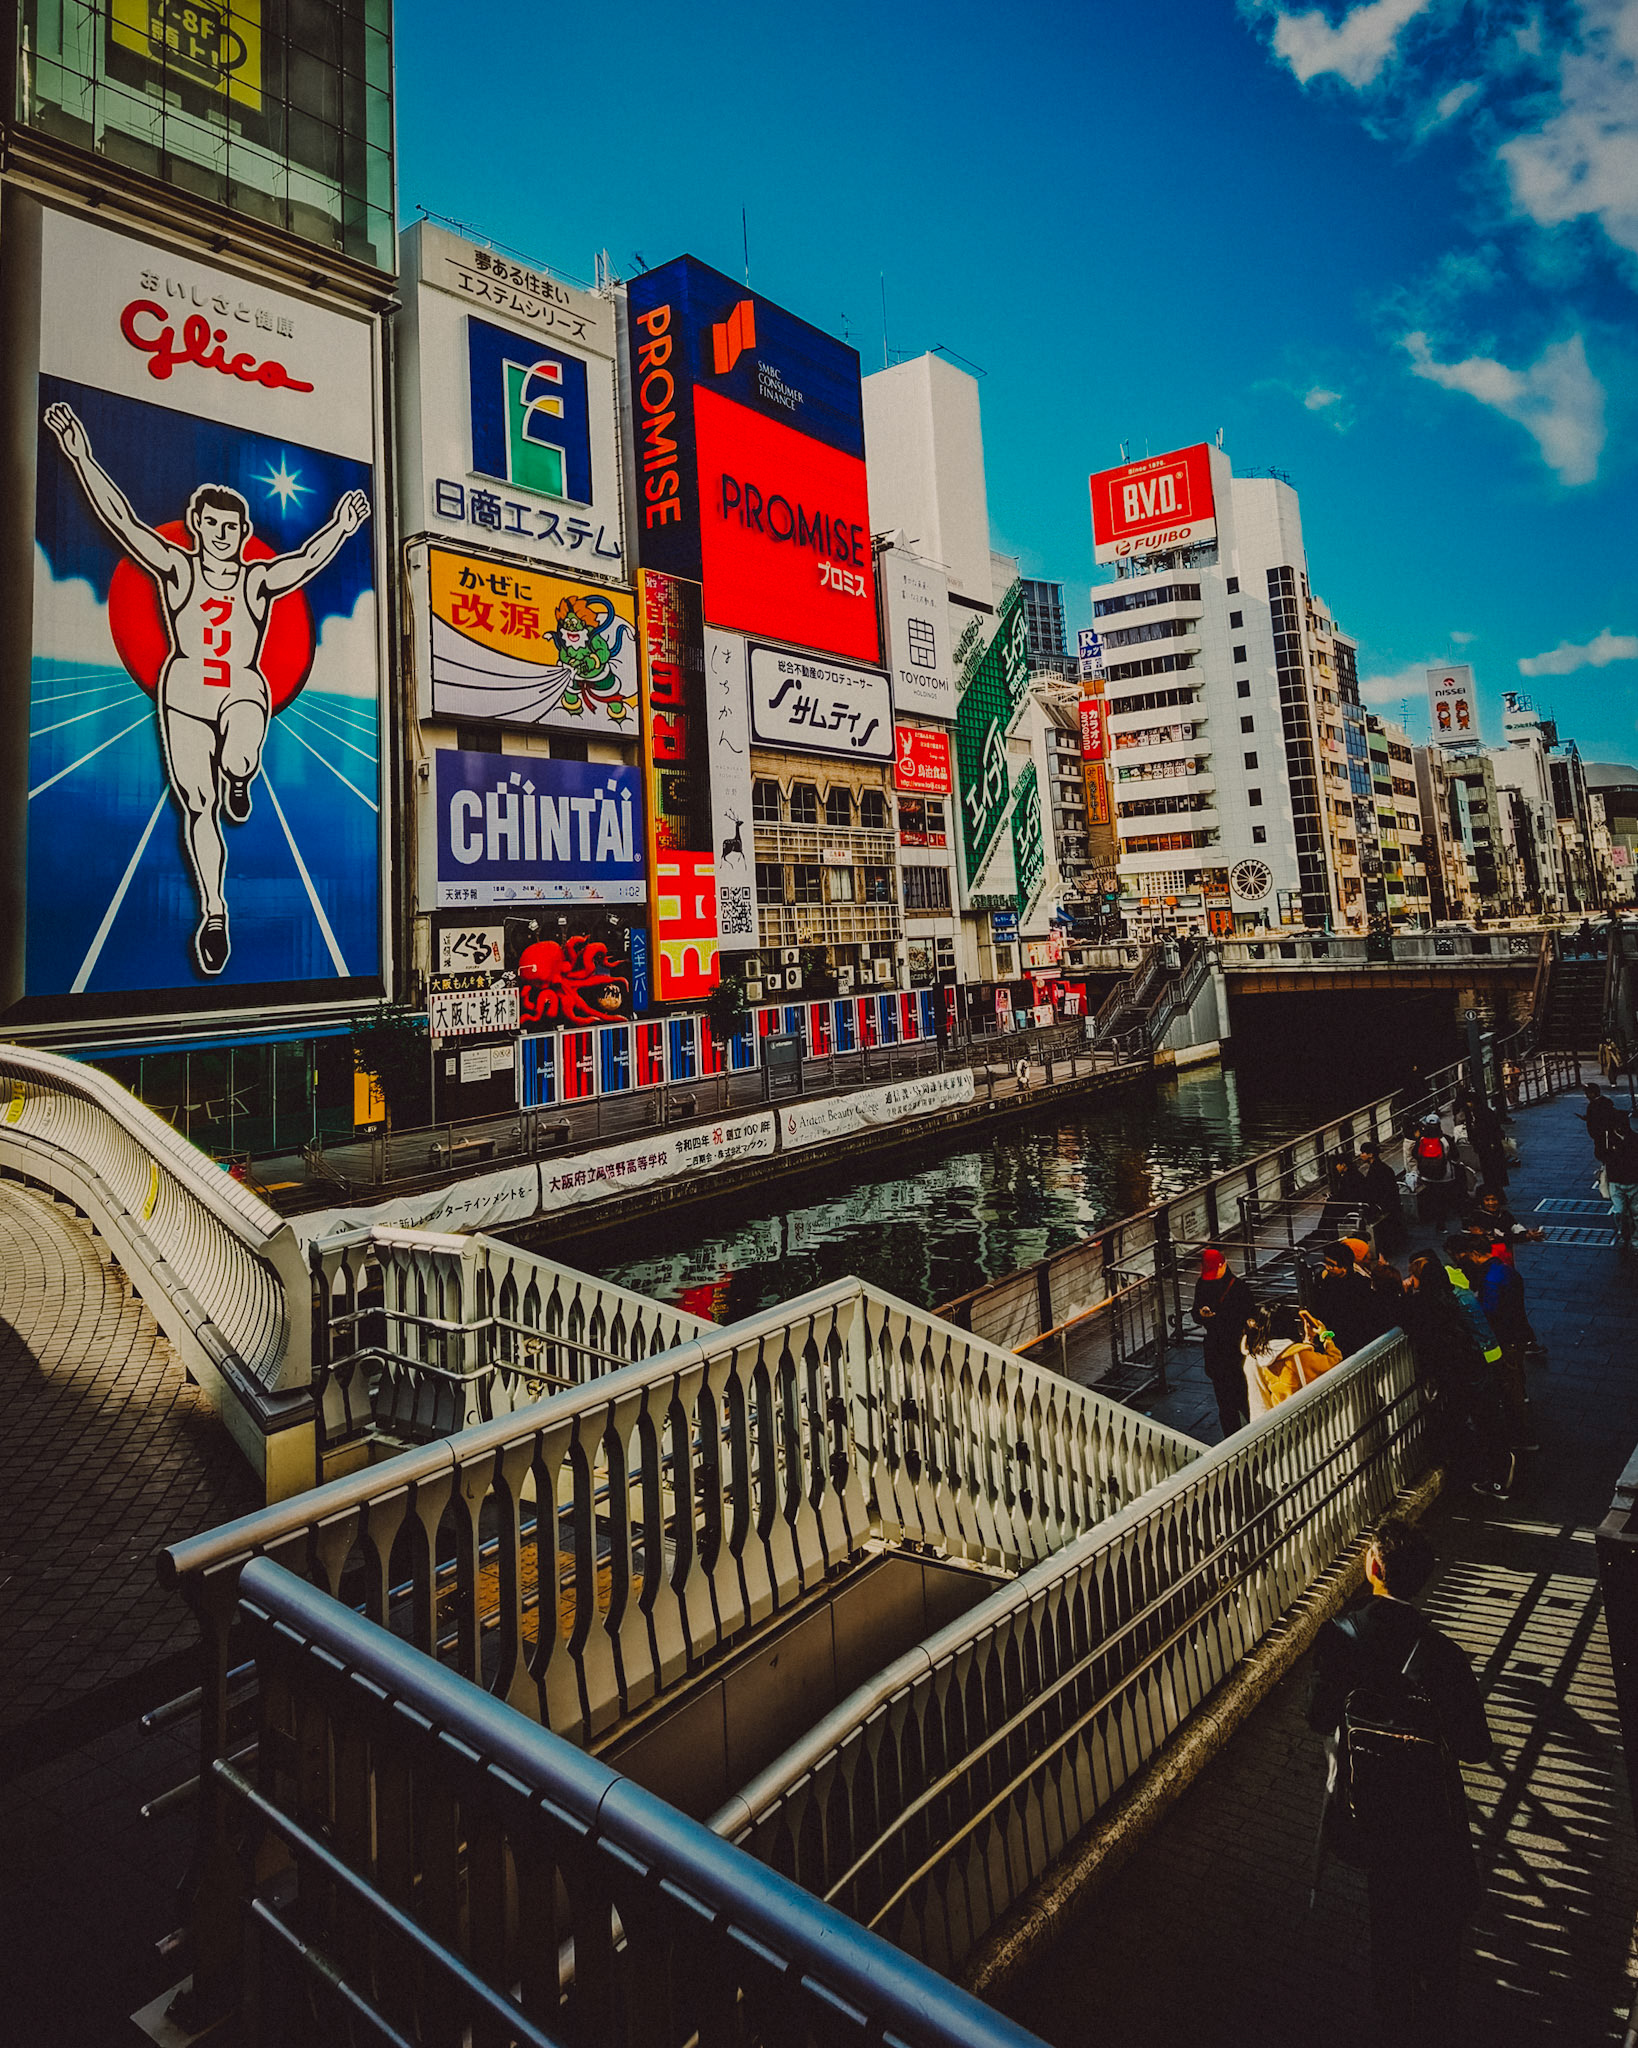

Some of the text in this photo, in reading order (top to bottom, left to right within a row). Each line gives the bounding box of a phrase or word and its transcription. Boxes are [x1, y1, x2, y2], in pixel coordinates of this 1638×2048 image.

[474, 250, 570, 304] 夢ある住まい
[140, 269, 293, 339] おいしさと健康
[458, 272, 586, 340] エステムシリーズ
[120, 299, 314, 393] Glico
[758, 360, 781, 380] SMBC
[758, 373, 804, 403] CONSUMER
[637, 304, 681, 529] PROMISE
[760, 384, 795, 411] FINANCE
[1123, 474, 1182, 523] B.V.D.
[435, 478, 622, 559] 日商エステム
[722, 473, 864, 567] PROMISE
[1134, 528, 1191, 550] FUJIBO
[458, 566, 532, 600] かぜに
[818, 561, 867, 598] プロミス
[450, 591, 541, 640] 改源
[200, 596, 235, 688] グリコ
[778, 660, 873, 689] 総合不動産のプロデューサー
[1435, 688, 1466, 696] NISSEI
[789, 695, 861, 733] サムティ
[1081, 711, 1091, 750] JOYSOUND
[1089, 709, 1101, 750] カラオケ
[445, 888, 478, 900] 天気予報
[452, 932, 492, 965] くくる
[435, 998, 507, 1029] 大阪に乾杯
[800, 1110, 826, 1128] Ardent
[828, 1107, 855, 1121] Beauty
[675, 1135, 710, 1154] 令和四年
[712, 1128, 723, 1145] 祝
[549, 1151, 668, 1193] 大阪府立阿倍野高等学校
